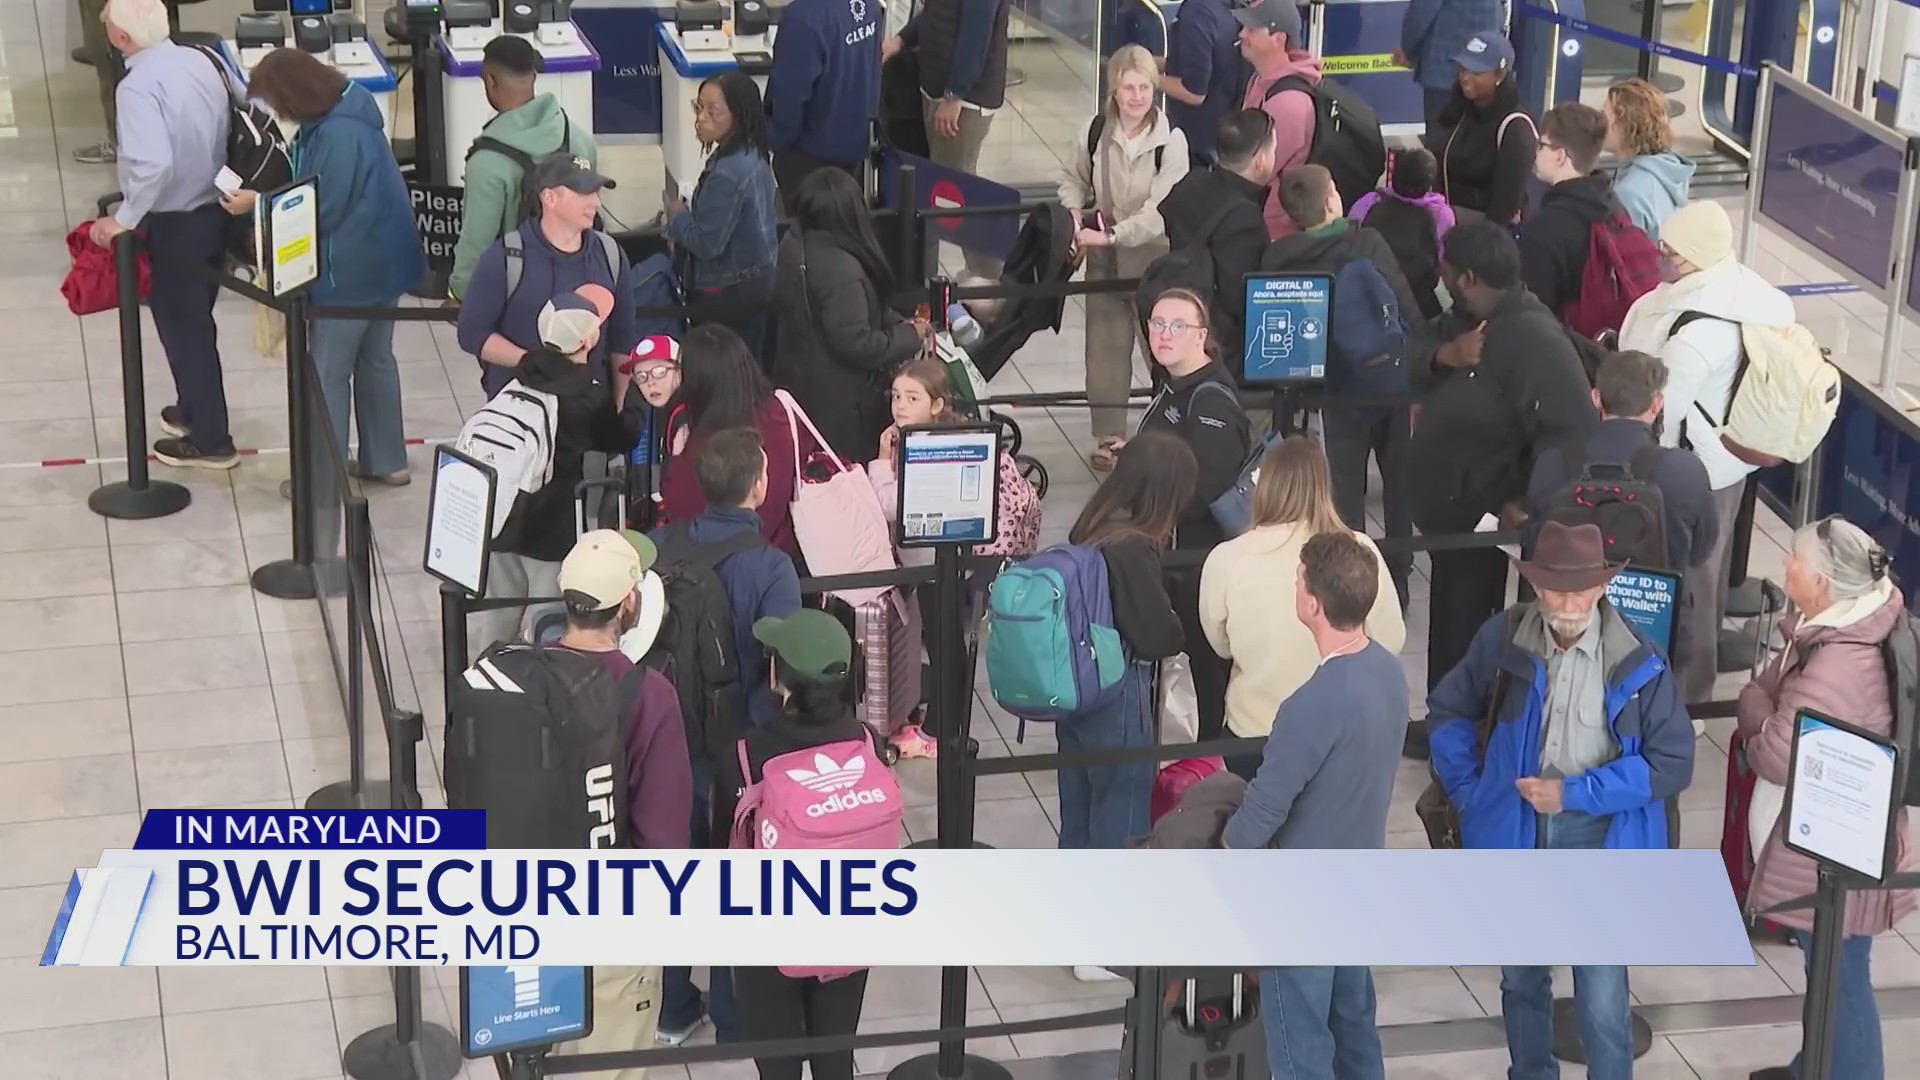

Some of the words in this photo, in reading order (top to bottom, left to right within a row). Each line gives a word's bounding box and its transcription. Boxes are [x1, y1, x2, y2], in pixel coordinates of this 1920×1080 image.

[613, 63, 637, 77] Less
[1322, 60, 1369, 70] Welcome
[1372, 58, 1393, 68] Bac
[410, 189, 464, 212] Plea
[416, 213, 461, 235] Wait
[423, 235, 453, 256] er
[1265, 281, 1301, 290] DIGITAL
[1303, 281, 1314, 290] ID
[1270, 333, 1282, 343] ID
[1610, 575, 1638, 585] your
[1639, 576, 1653, 589] ID
[1654, 579, 1668, 591] to
[1606, 584, 1643, 597] phone
[1645, 590, 1672, 604] with
[585, 763, 616, 848] UFC
[806, 787, 887, 817] adidas
[494, 1013, 512, 1025] Line
[513, 1008, 538, 1021] Starts
[540, 1005, 561, 1017] Here
